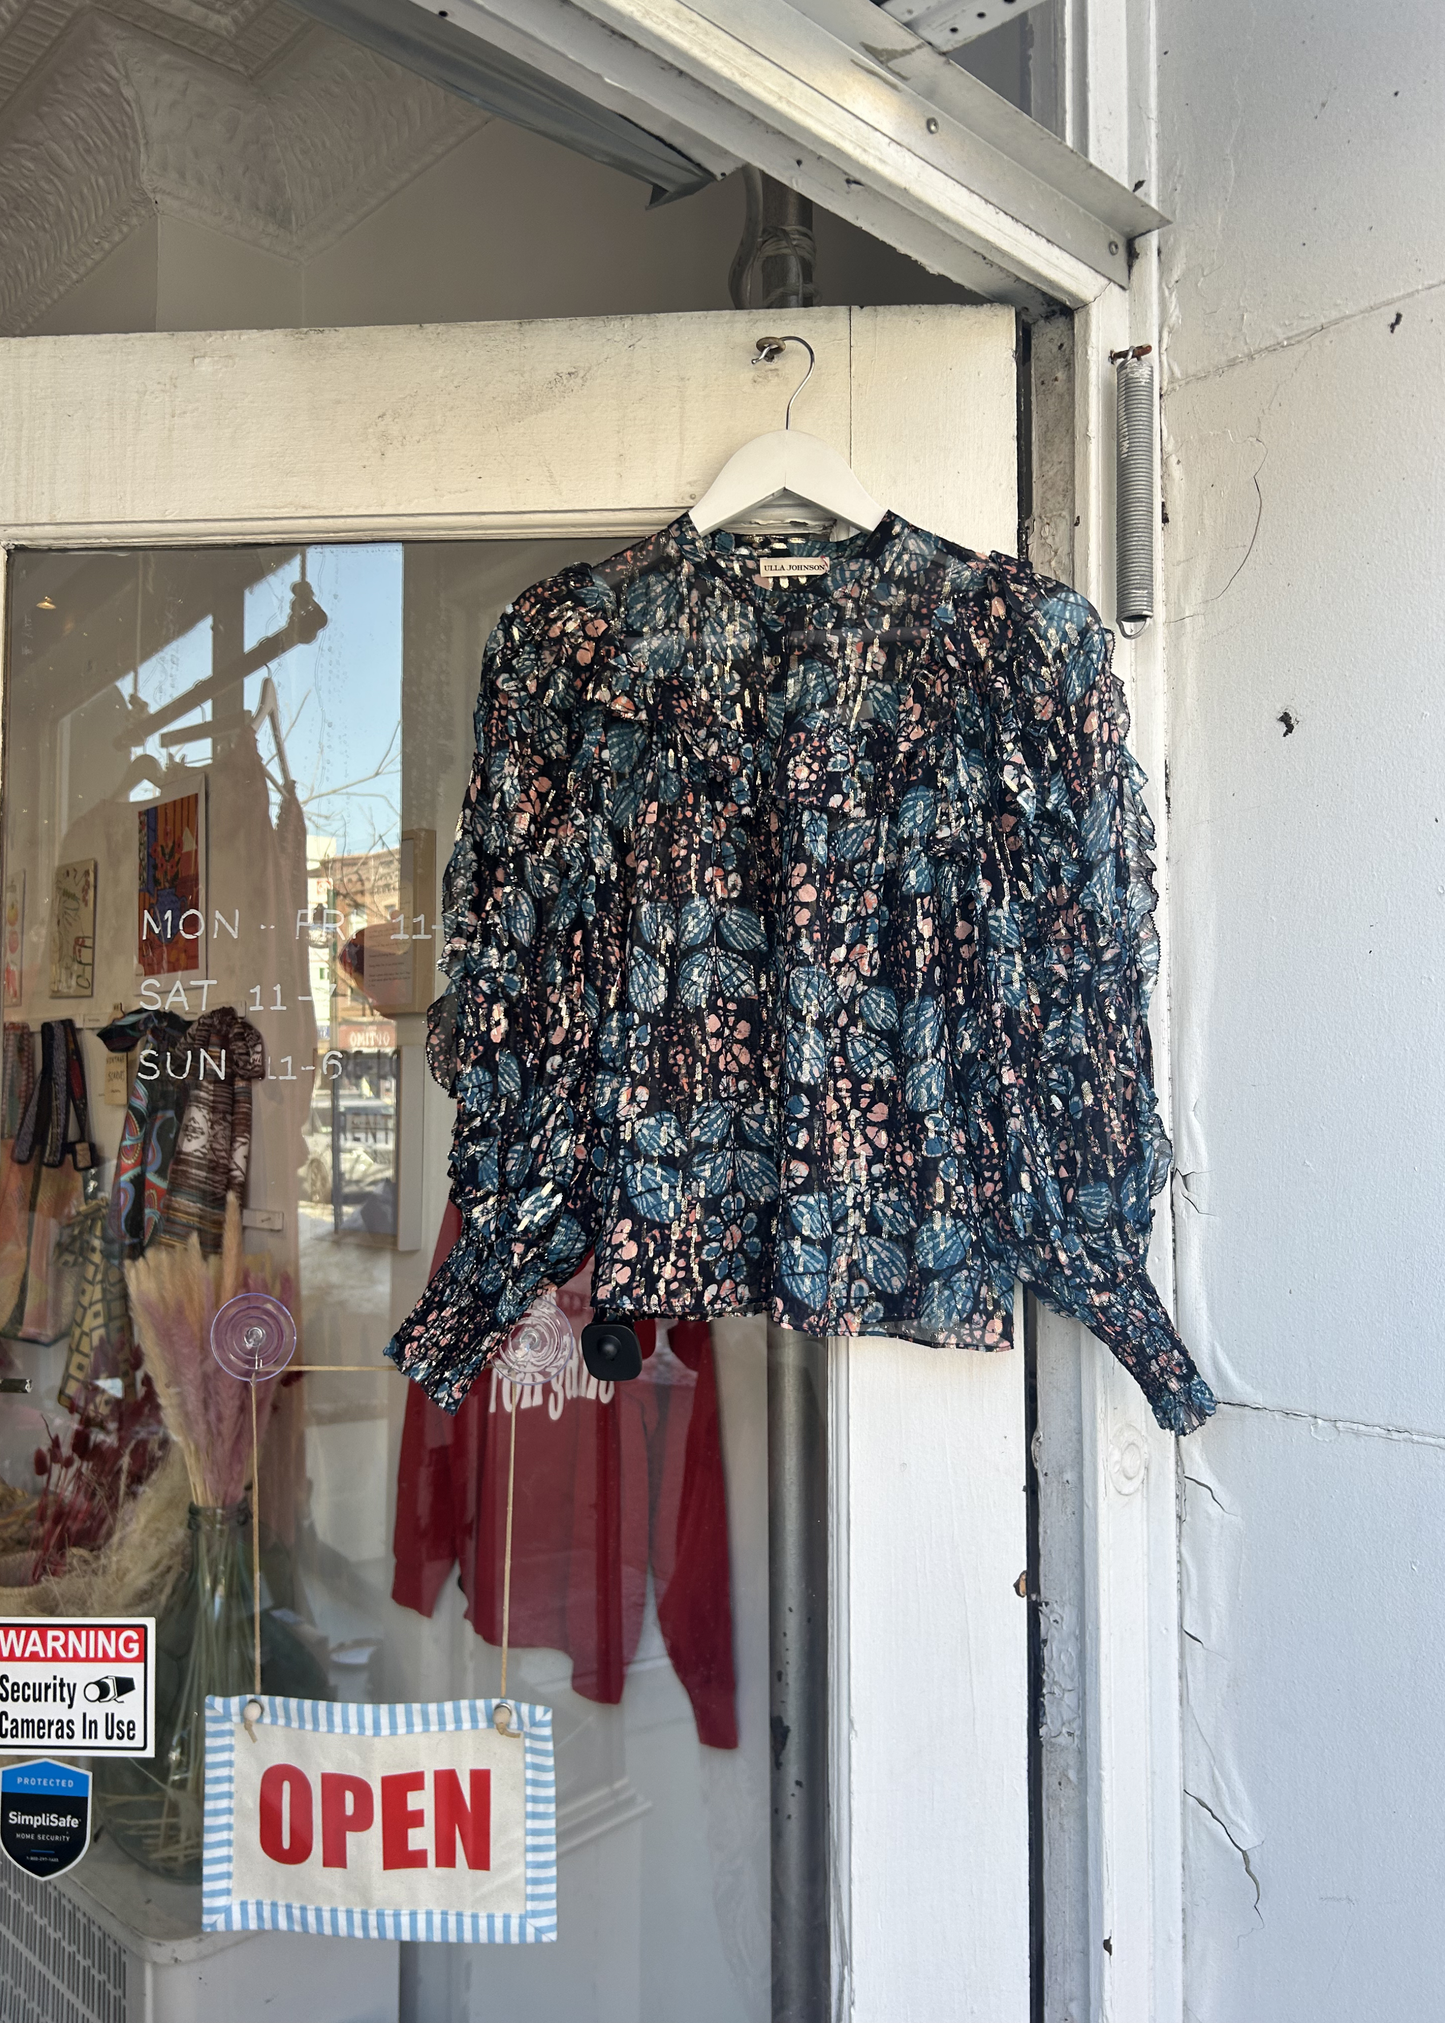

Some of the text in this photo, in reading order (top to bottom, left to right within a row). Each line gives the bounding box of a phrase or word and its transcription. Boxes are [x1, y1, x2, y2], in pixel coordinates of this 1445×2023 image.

[764, 564, 826, 572] ULLA JOHNSON
[142, 908, 240, 940] MON
[139, 979, 218, 1012] SAT
[137, 1048, 227, 1080] SUN
[0, 1629, 140, 1658] WARNING
[0, 1673, 77, 1709] Security
[0, 1710, 136, 1741] Cameras In Use
[16, 1777, 74, 1788] PROTECTED
[8, 1811, 79, 1828] SimpliSafe
[259, 1763, 491, 1871] OPEN
[37, 1833, 71, 1842] SECURITY
